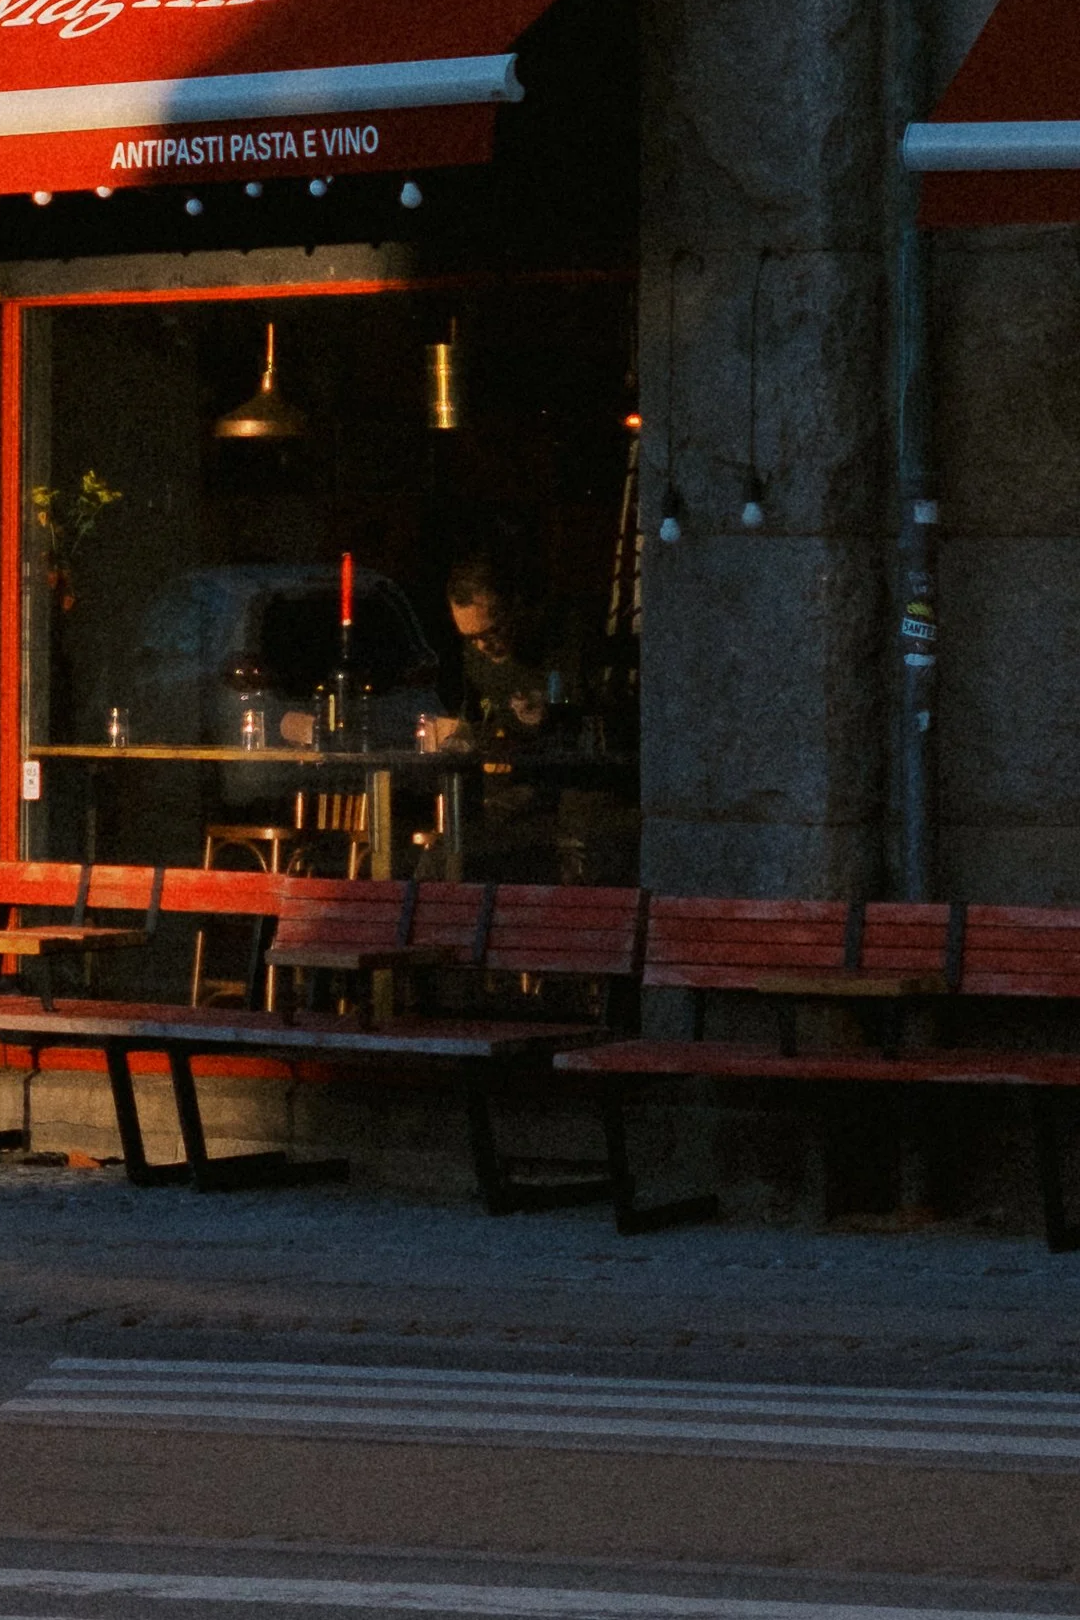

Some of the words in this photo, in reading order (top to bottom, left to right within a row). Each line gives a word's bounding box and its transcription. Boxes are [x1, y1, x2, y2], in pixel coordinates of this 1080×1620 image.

[110, 134, 224, 170] ANTIPASTI
[230, 131, 299, 162] PASTA
[304, 129, 317, 158] E
[321, 125, 379, 156] VINO
